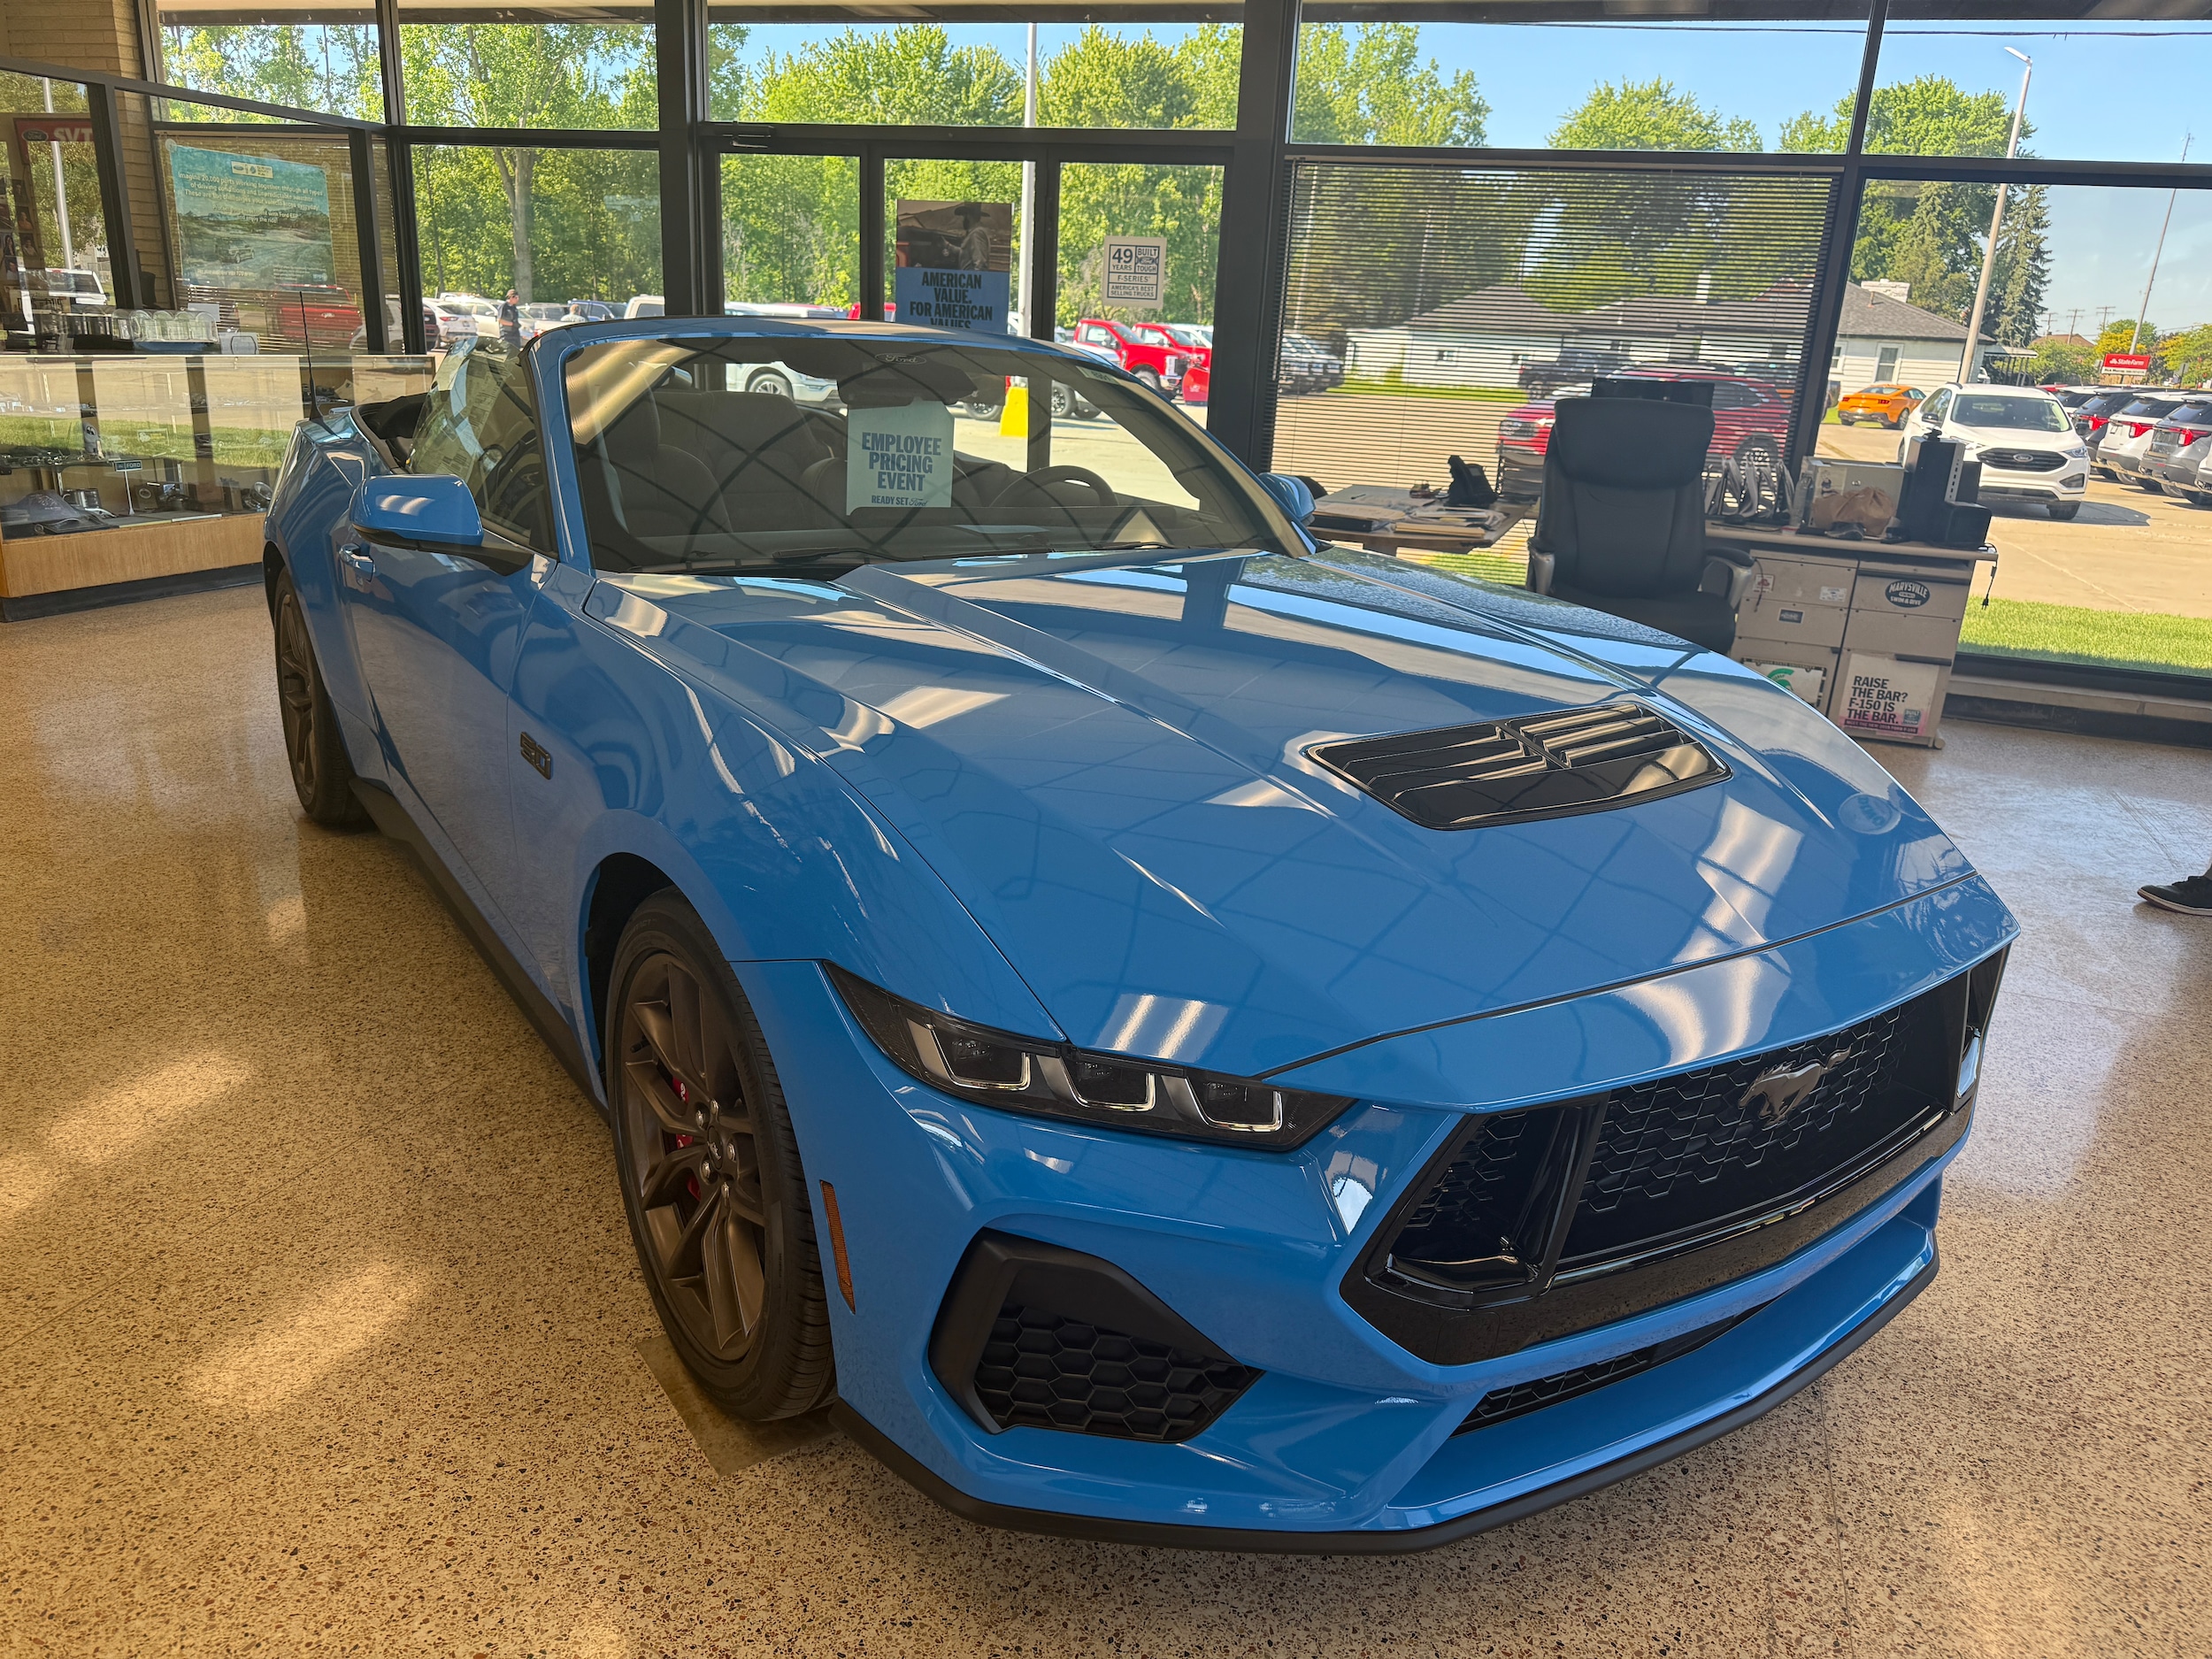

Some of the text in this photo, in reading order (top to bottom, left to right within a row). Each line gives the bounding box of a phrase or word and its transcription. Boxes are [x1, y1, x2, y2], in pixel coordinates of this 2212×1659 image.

[1112, 248, 1133, 264] 49
[1137, 248, 1157, 257] BUILT
[922, 271, 982, 289] AMERICAN
[933, 287, 972, 304] VALUE.
[910, 301, 993, 321] FOR AMERICAN
[862, 432, 942, 456] EMPLOYEE
[869, 451, 933, 474] PRICING
[877, 472, 926, 492] EVENT
[872, 495, 928, 507] READY SET Ford
[1888, 581, 1928, 598] MARYSVILLE
[1853, 675, 1890, 689] RAISE
[1851, 686, 1909, 703] THE BAR?
[1848, 697, 1895, 712] F-150 IS
[1847, 708, 1899, 724] THE BAR.
